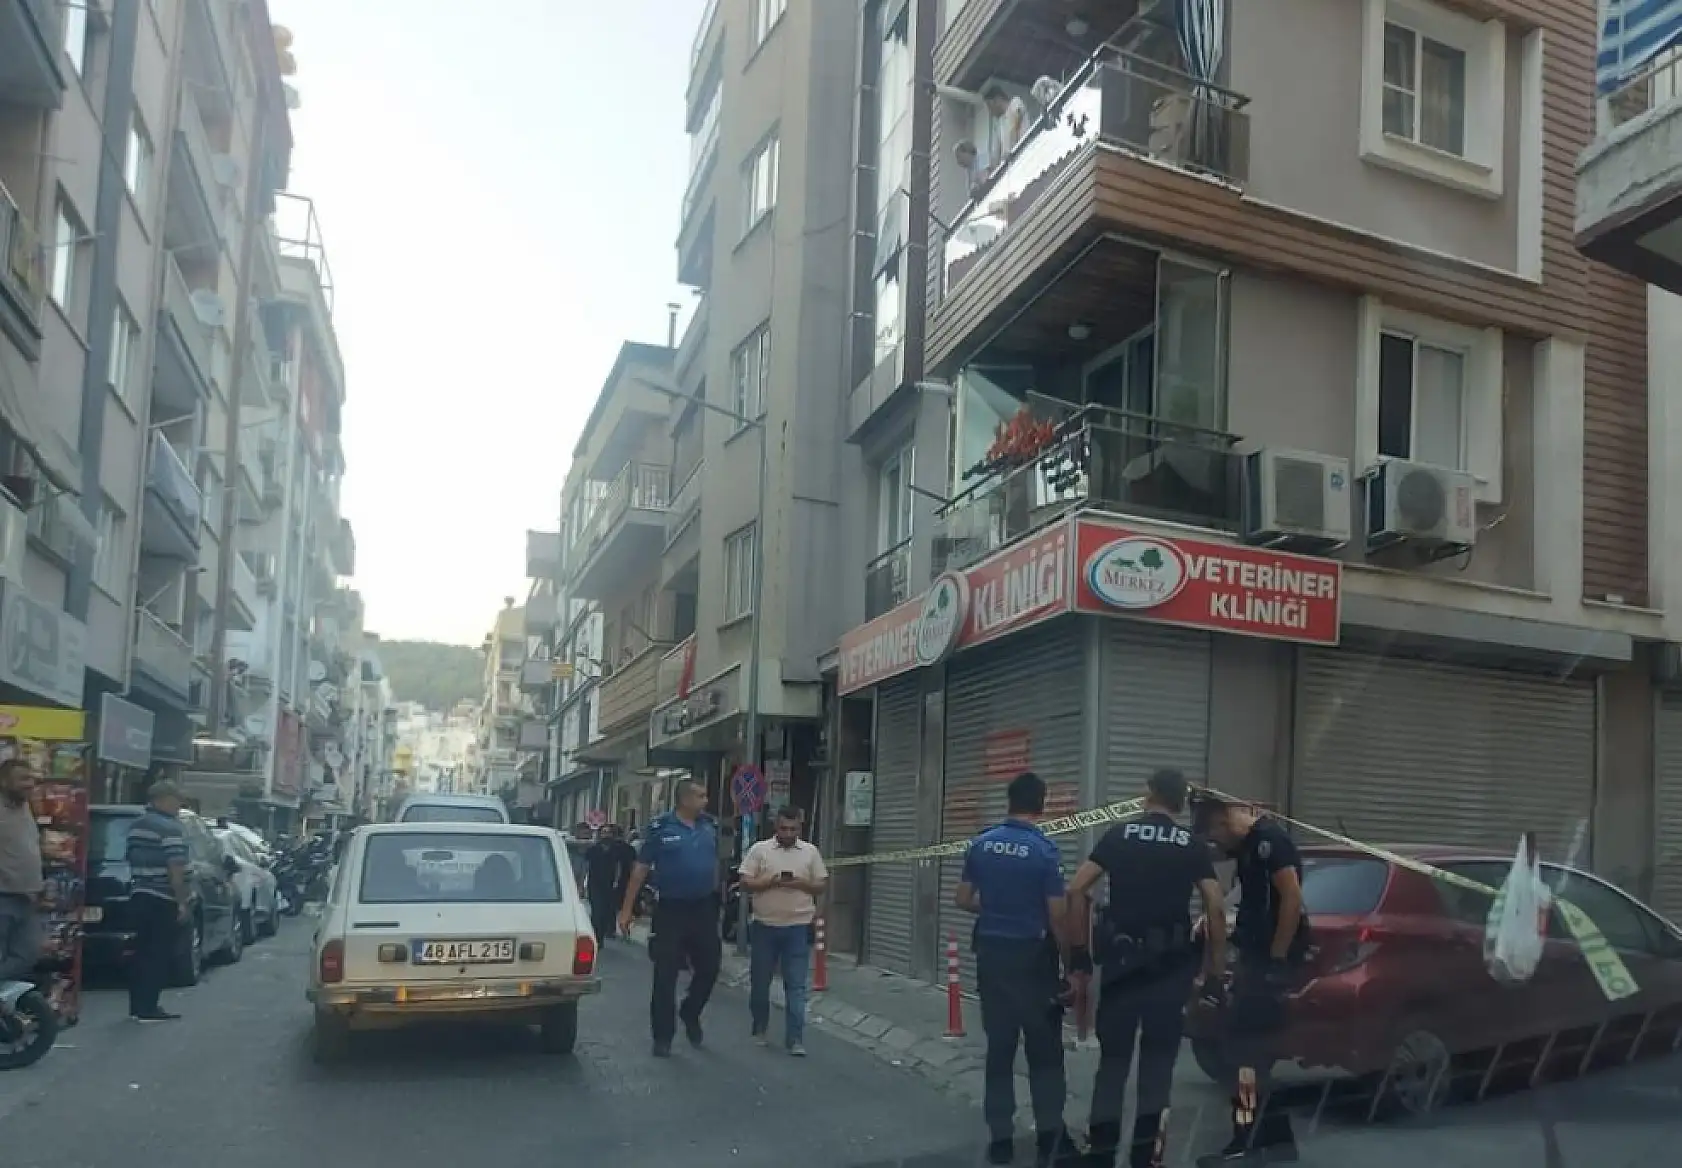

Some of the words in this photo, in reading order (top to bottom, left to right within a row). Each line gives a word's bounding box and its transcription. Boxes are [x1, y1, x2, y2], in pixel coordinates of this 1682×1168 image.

[974, 535, 1065, 634] KLİNİĞİ
[1184, 554, 1335, 599] VETERİNER
[1210, 592, 1308, 629] KLİNİĞİ
[424, 943, 445, 958] 48
[448, 943, 477, 958] AFL
[481, 943, 510, 958] 215
